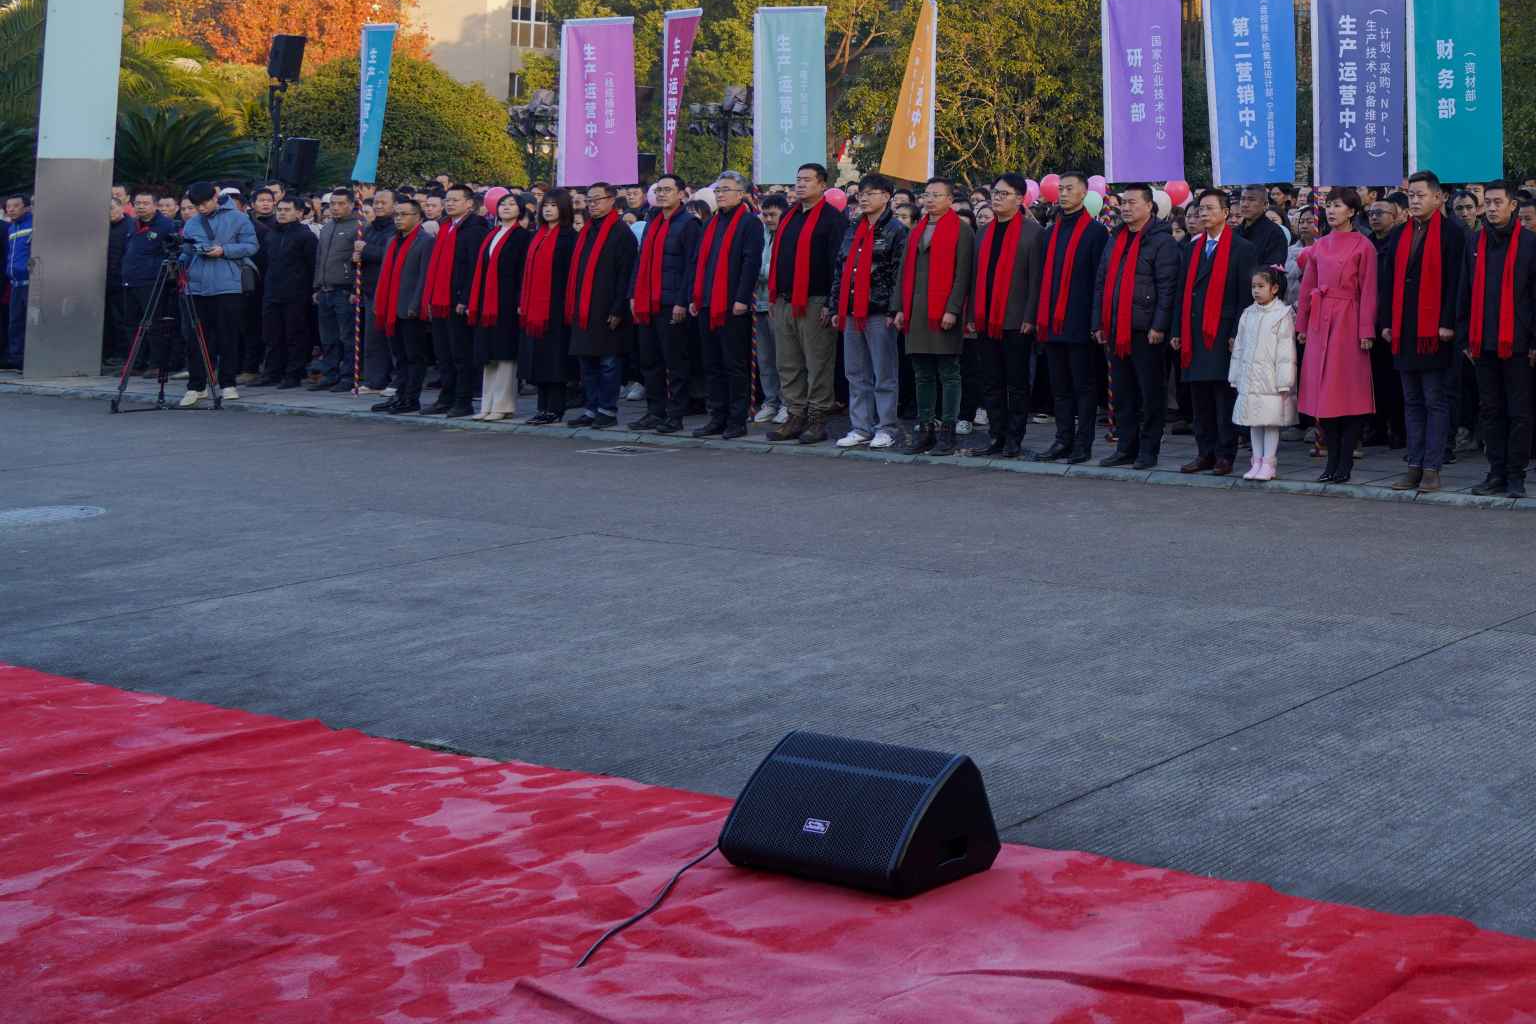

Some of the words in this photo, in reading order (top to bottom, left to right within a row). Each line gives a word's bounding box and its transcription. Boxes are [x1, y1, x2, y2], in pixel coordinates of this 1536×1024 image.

[584, 43, 599, 158] 生产运营中心
[776, 33, 794, 155] 生产运营中心
[1126, 47, 1146, 123] 研发部
[1232, 16, 1258, 150] 第二营销中心
[1338, 14, 1358, 152] 生产运营中心
[1436, 38, 1456, 120] 财务部
